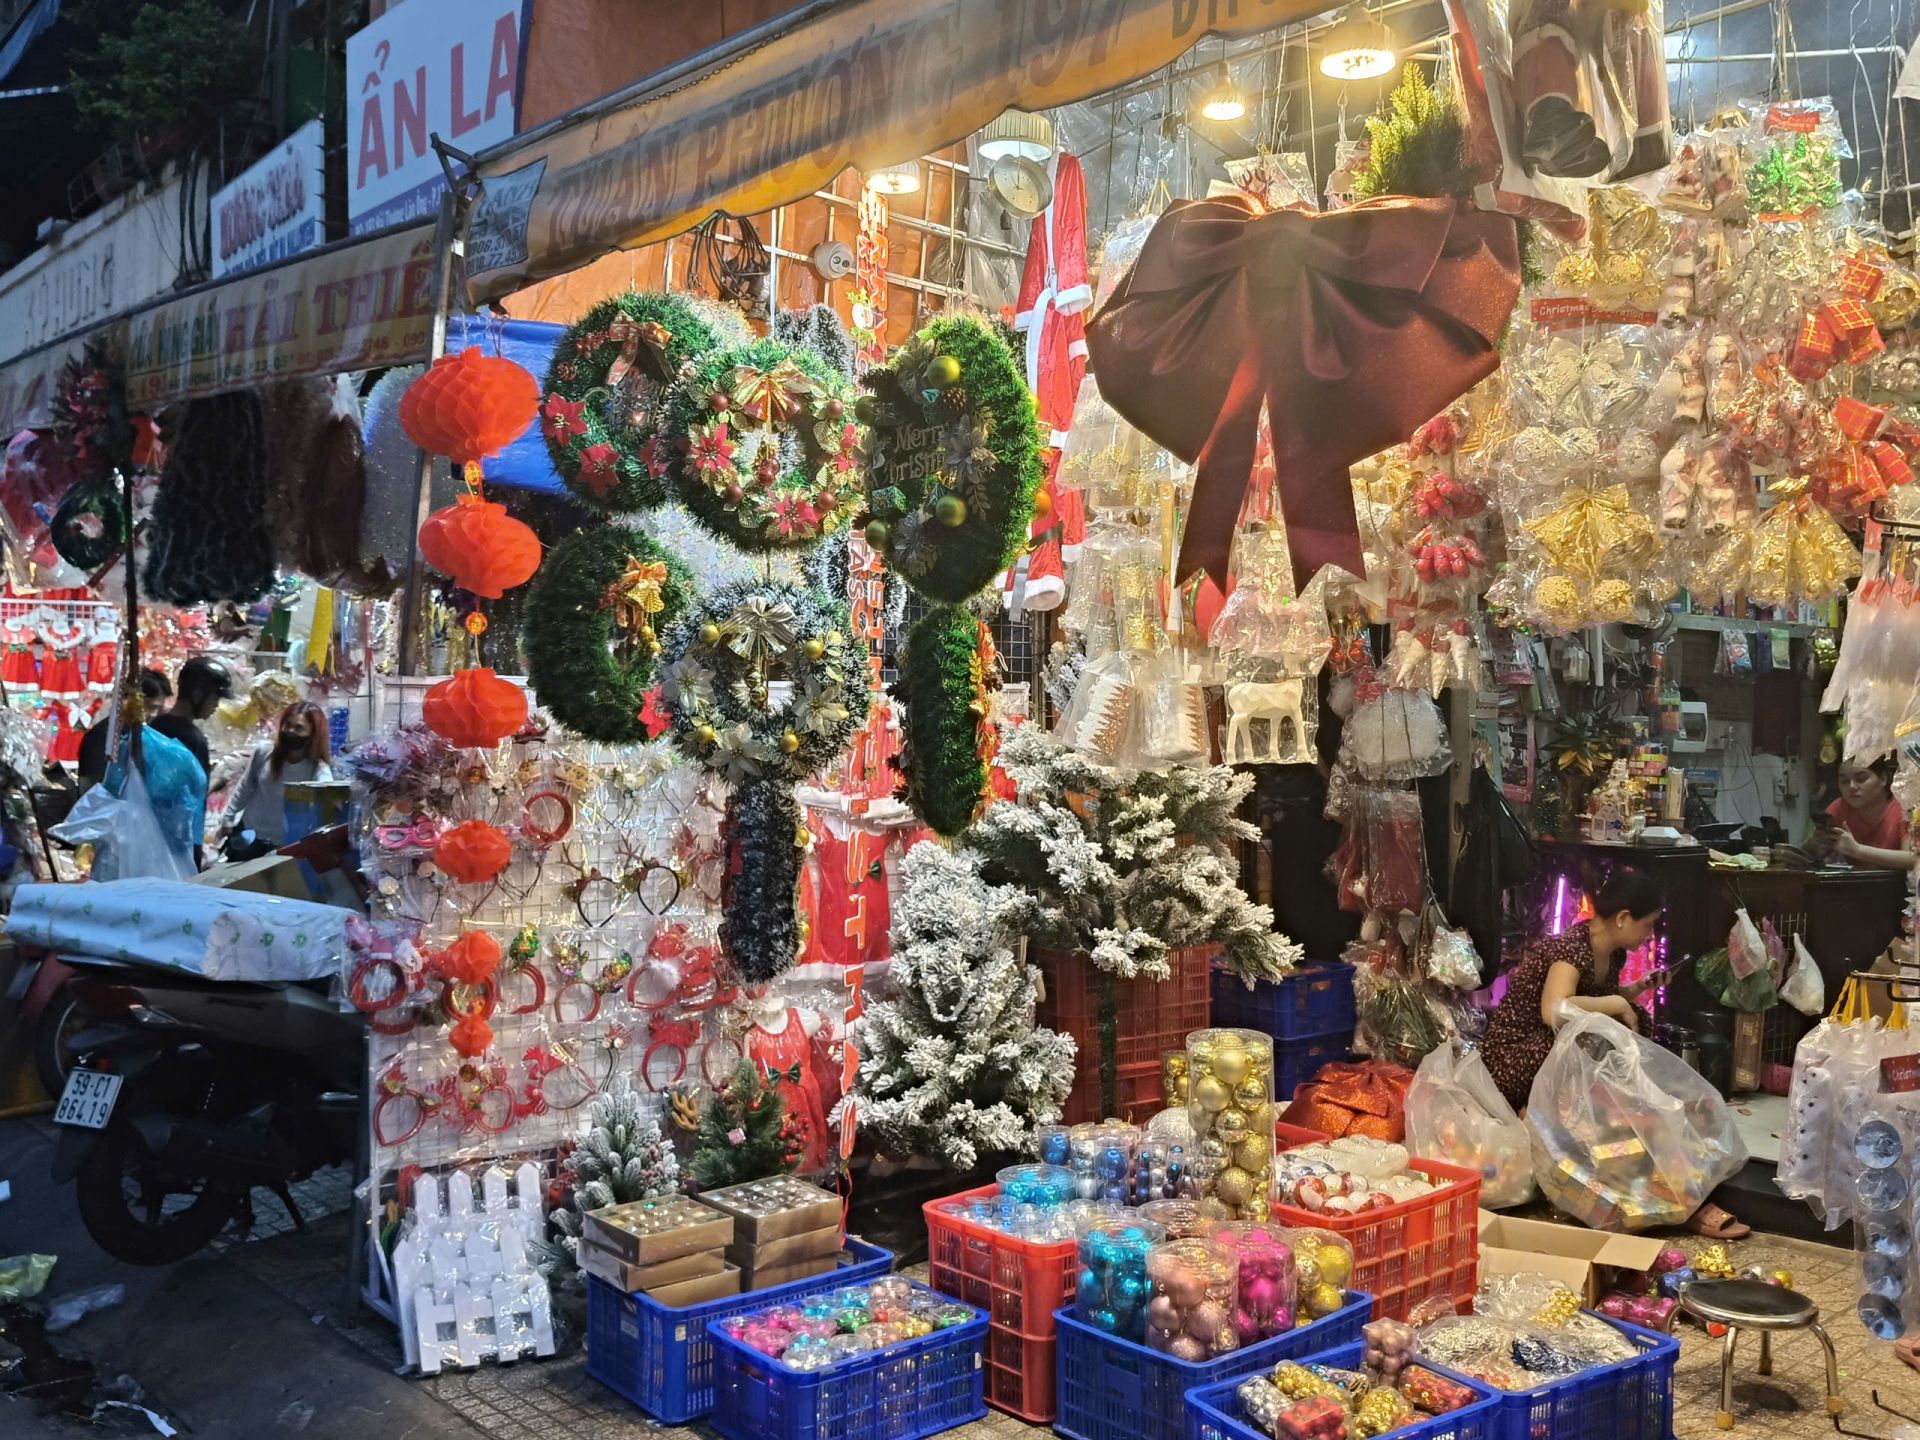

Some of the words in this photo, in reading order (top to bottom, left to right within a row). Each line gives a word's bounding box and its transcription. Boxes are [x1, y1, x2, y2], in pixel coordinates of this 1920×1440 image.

[356, 39, 427, 190] ẨN
[450, 11, 520, 139] LA
[313, 239, 437, 336] THIÊ
[58, 1097, 109, 1125] 864.19
[72, 1073, 112, 1099] 59-C1
